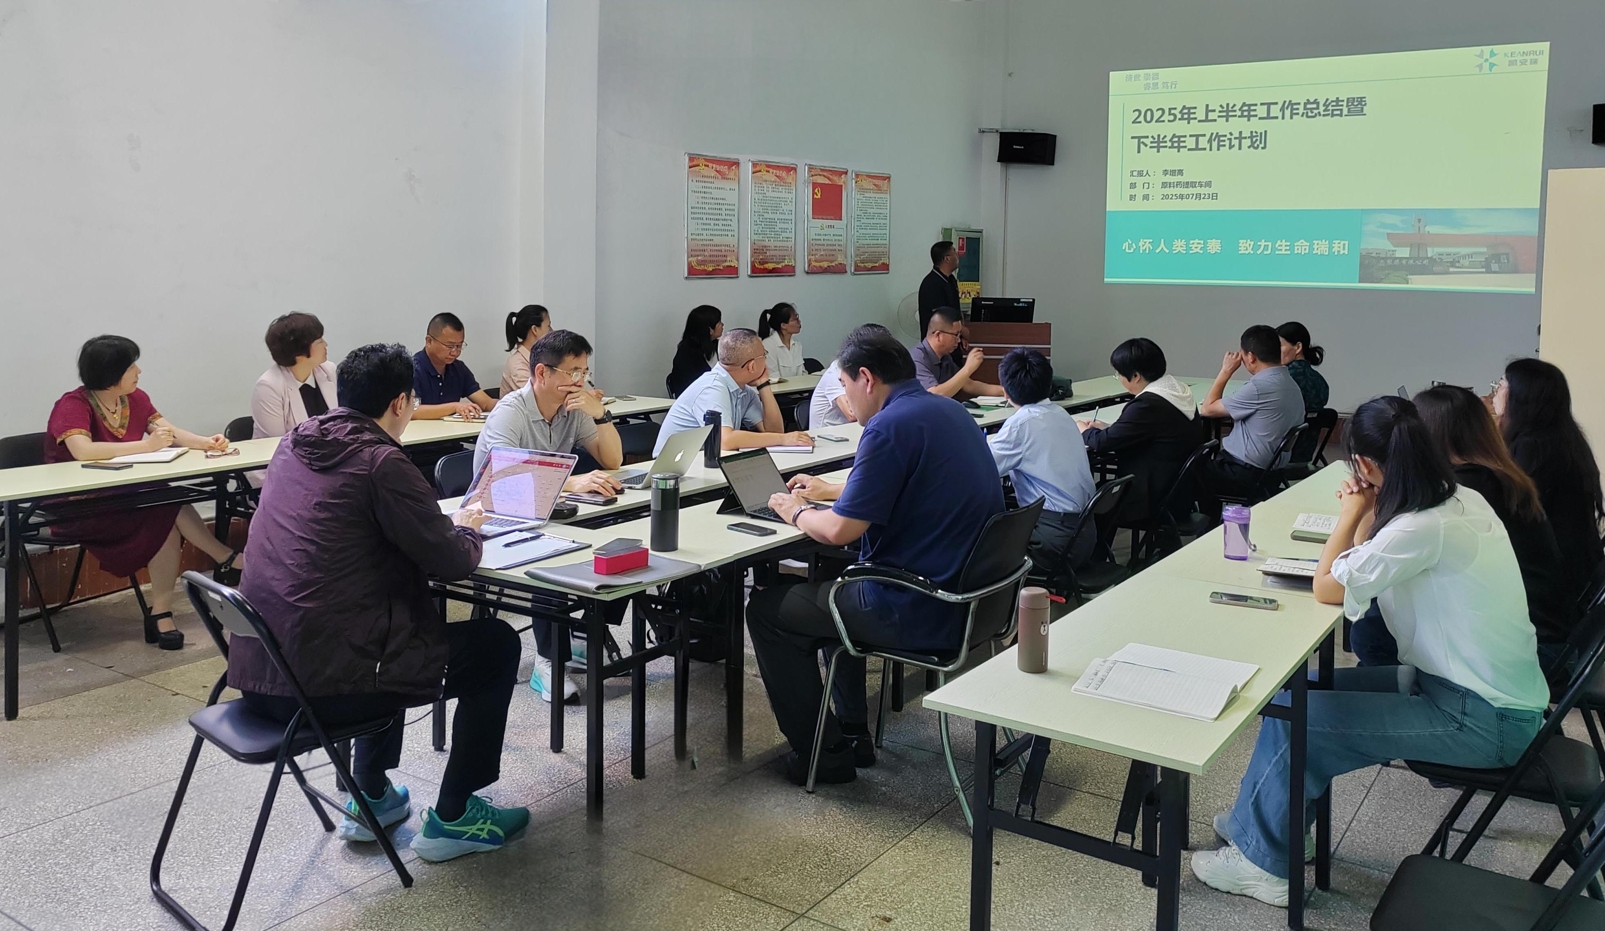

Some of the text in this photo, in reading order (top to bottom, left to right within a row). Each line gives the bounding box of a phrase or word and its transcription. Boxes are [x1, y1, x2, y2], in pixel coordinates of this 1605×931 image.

[1503, 49, 1544, 58] KEANRUI
[1131, 96, 1367, 125] 2025年上半年工作总结暨
[1130, 130, 1268, 155] 下半年工作计划
[1160, 180, 1212, 189] 原料药提取车间
[1160, 192, 1219, 201] 2025年07月23日
[1122, 238, 1350, 256] 心怀人类安泰 致力生命瑞和
